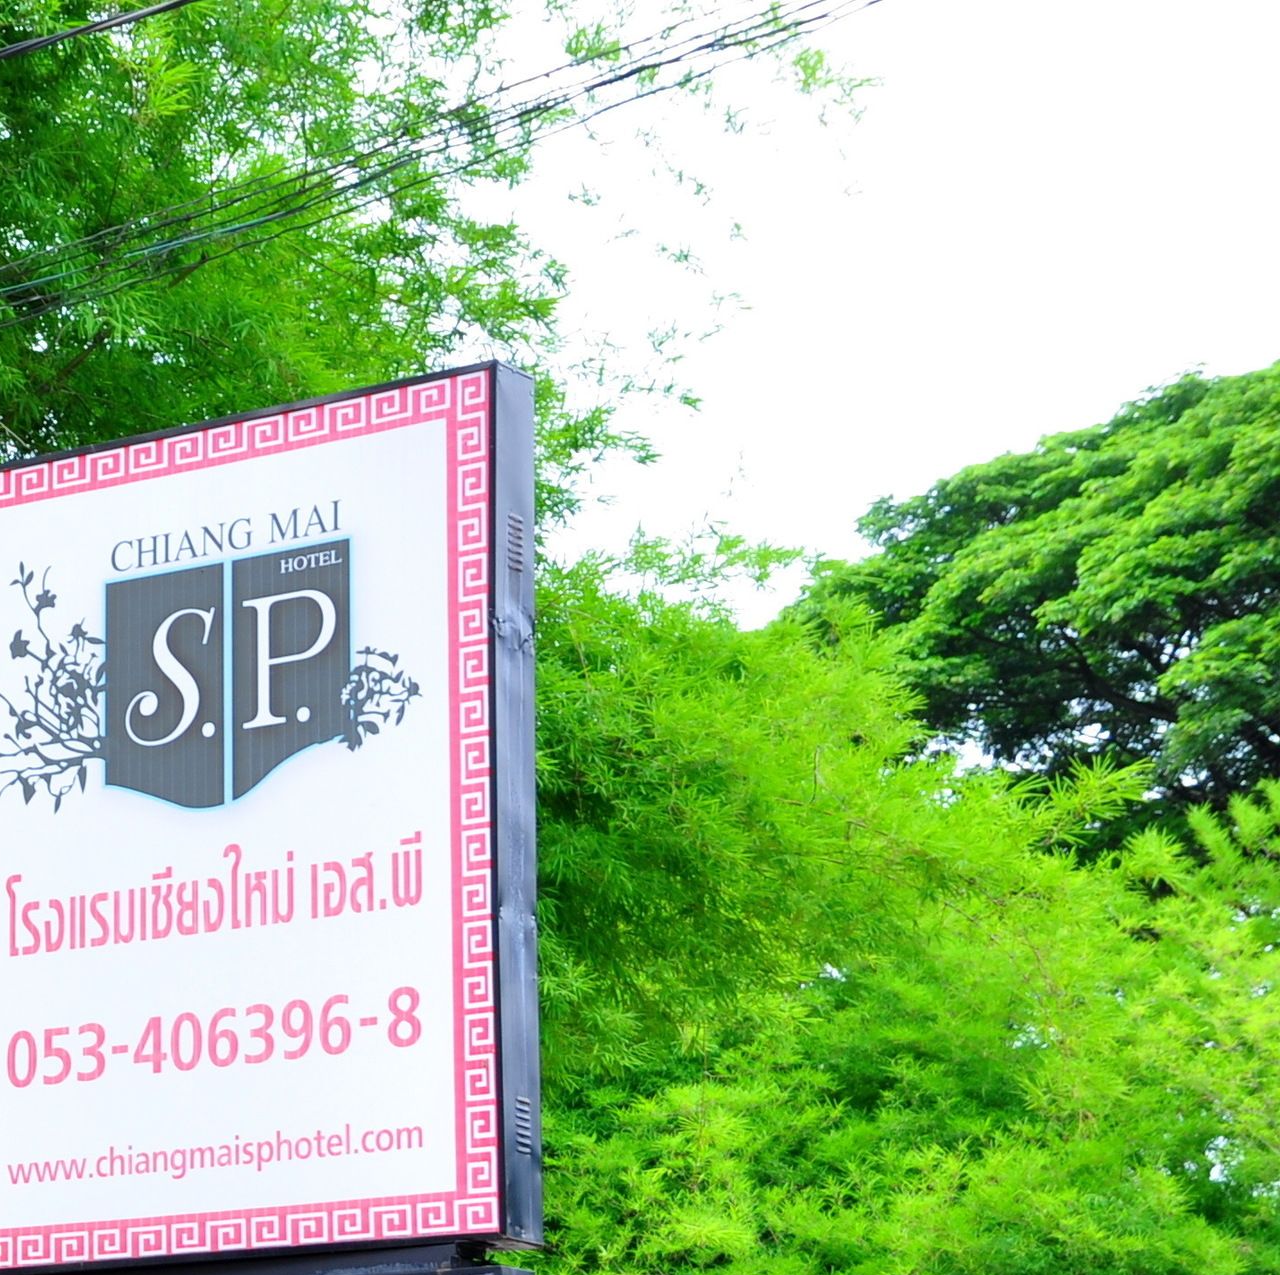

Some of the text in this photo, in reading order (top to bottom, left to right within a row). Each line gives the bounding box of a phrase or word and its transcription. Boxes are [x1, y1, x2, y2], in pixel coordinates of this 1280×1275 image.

[110, 499, 342, 573] CHIANG MAI
[280, 550, 343, 574] HOTEL
[5, 830, 423, 957] โรงแรมเชียงใหม่ เอส.พี
[6, 986, 423, 1089] 053-406396-8
[7, 1123, 424, 1185] www.chiangmaisphotel.com
